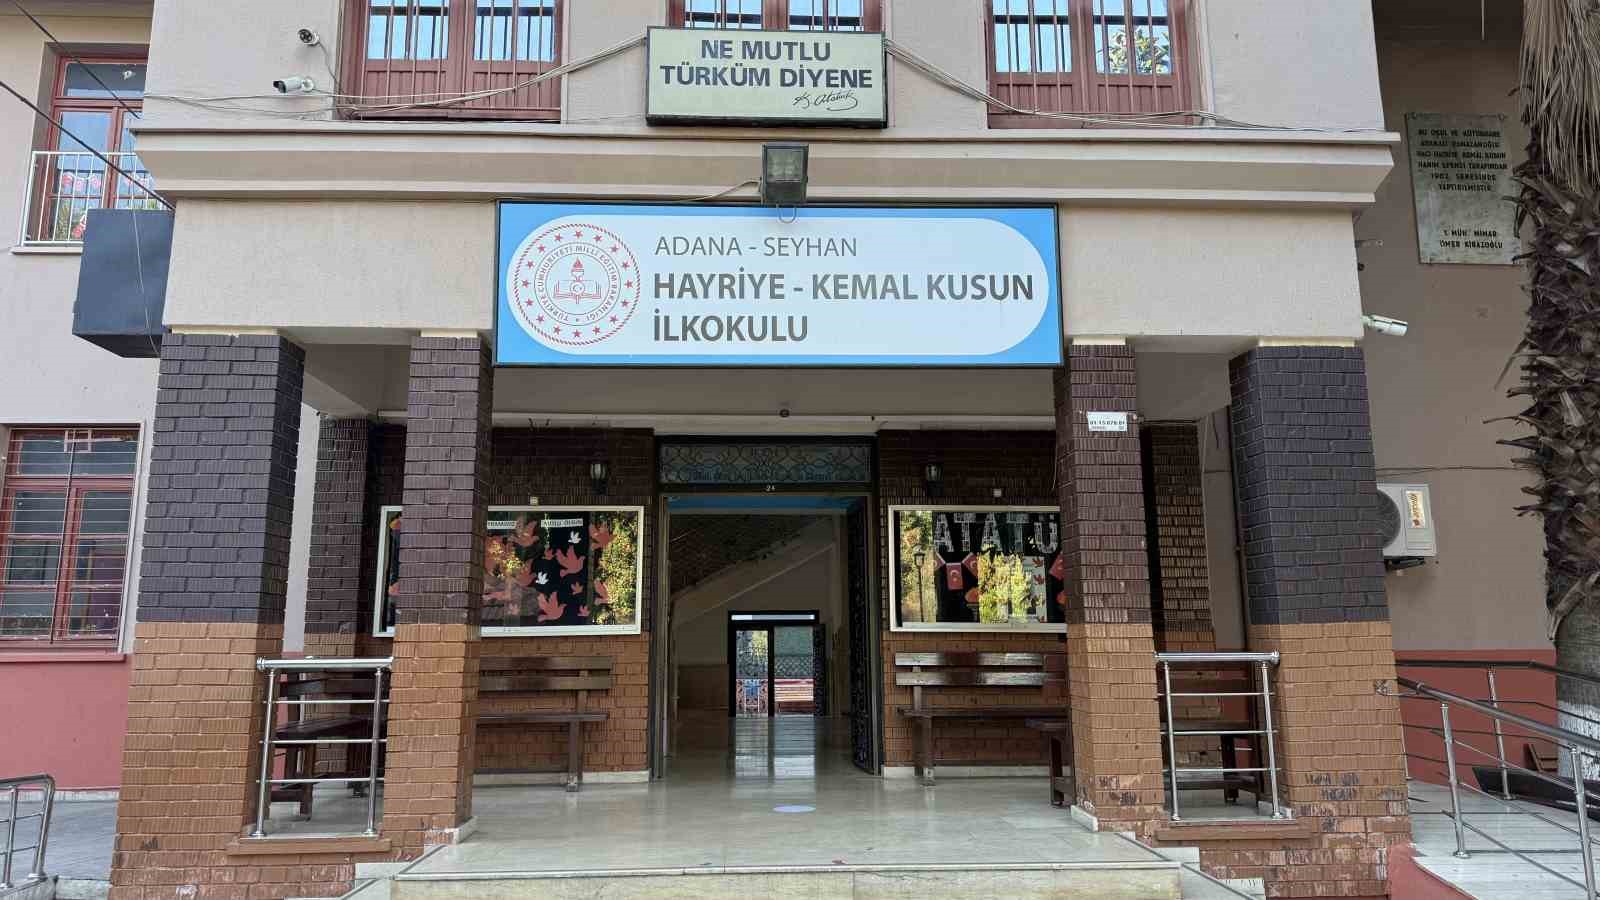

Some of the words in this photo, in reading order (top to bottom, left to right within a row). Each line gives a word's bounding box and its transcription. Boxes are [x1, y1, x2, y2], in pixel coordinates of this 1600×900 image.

[701, 39, 734, 60] NE
[741, 40, 831, 62] MUTLU
[659, 61, 771, 88] TÜRKÜM
[779, 64, 873, 89] DİYENE
[655, 236, 742, 256] ADANA
[763, 236, 857, 257] SEYHAN
[653, 266, 785, 300] HAYRİYE
[812, 273, 919, 300] KEMAL
[926, 274, 1034, 302] KUSUN
[653, 308, 808, 342] İLKOKULU
[934, 512, 1059, 553] ATATÜ
